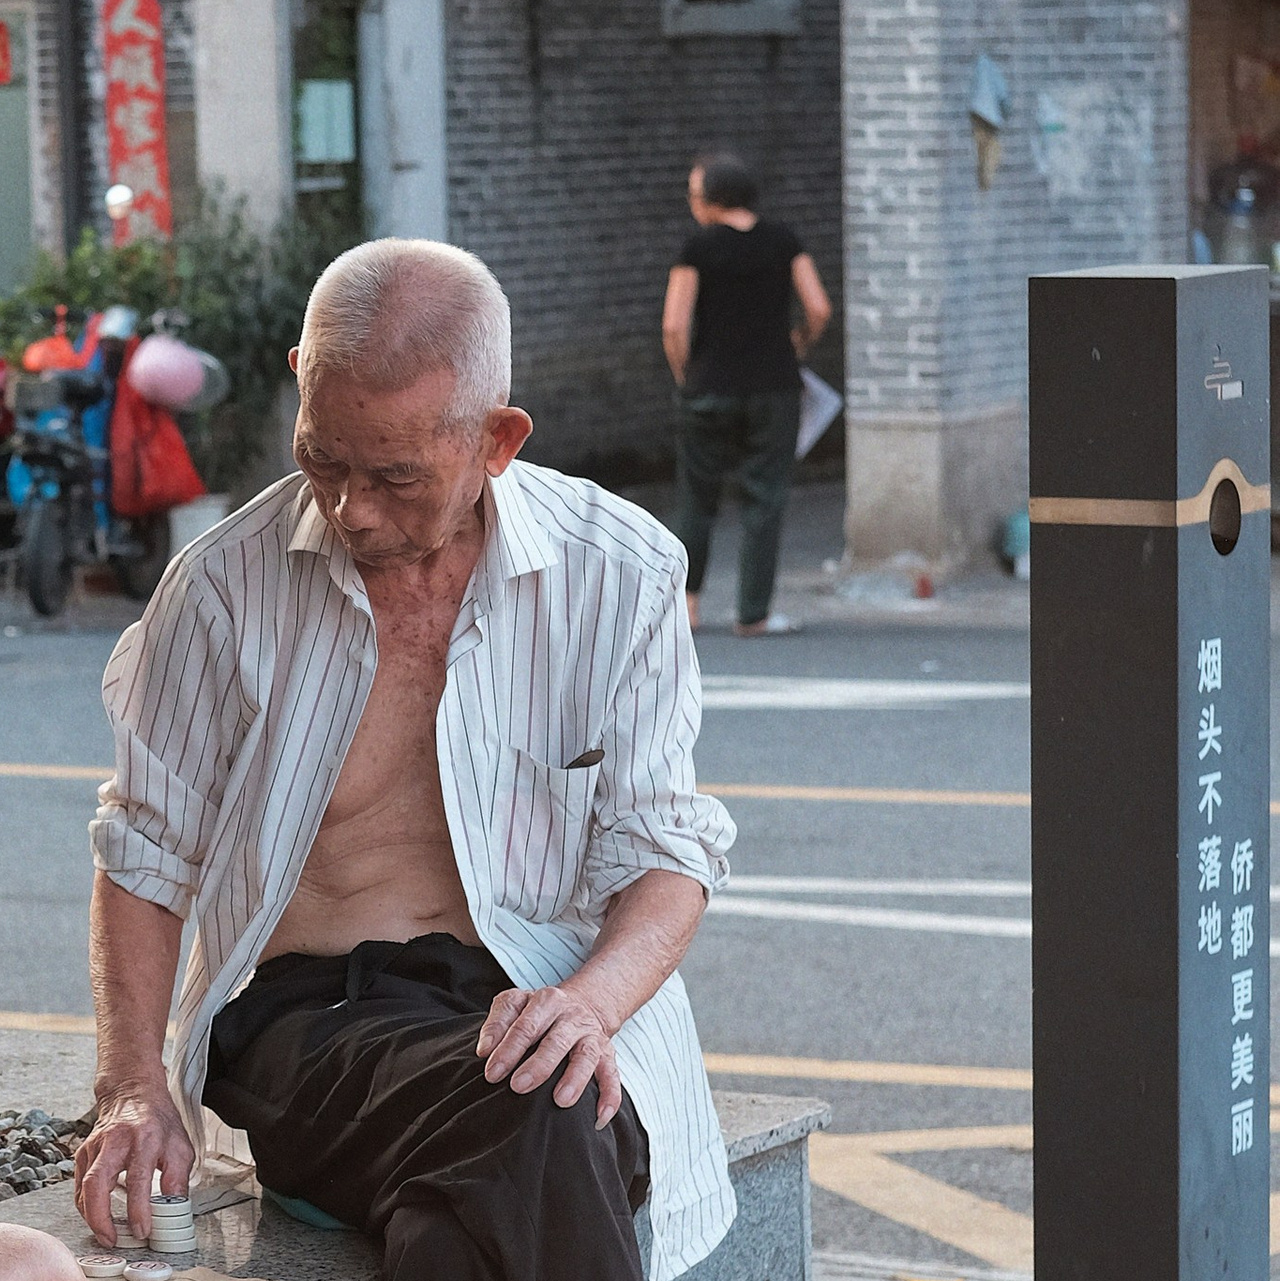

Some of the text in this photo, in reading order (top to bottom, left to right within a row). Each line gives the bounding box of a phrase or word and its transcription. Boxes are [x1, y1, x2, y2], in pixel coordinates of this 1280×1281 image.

[1197, 637, 1223, 958] 烟头不落地
[1230, 838, 1255, 1157] 侨都更美丽
